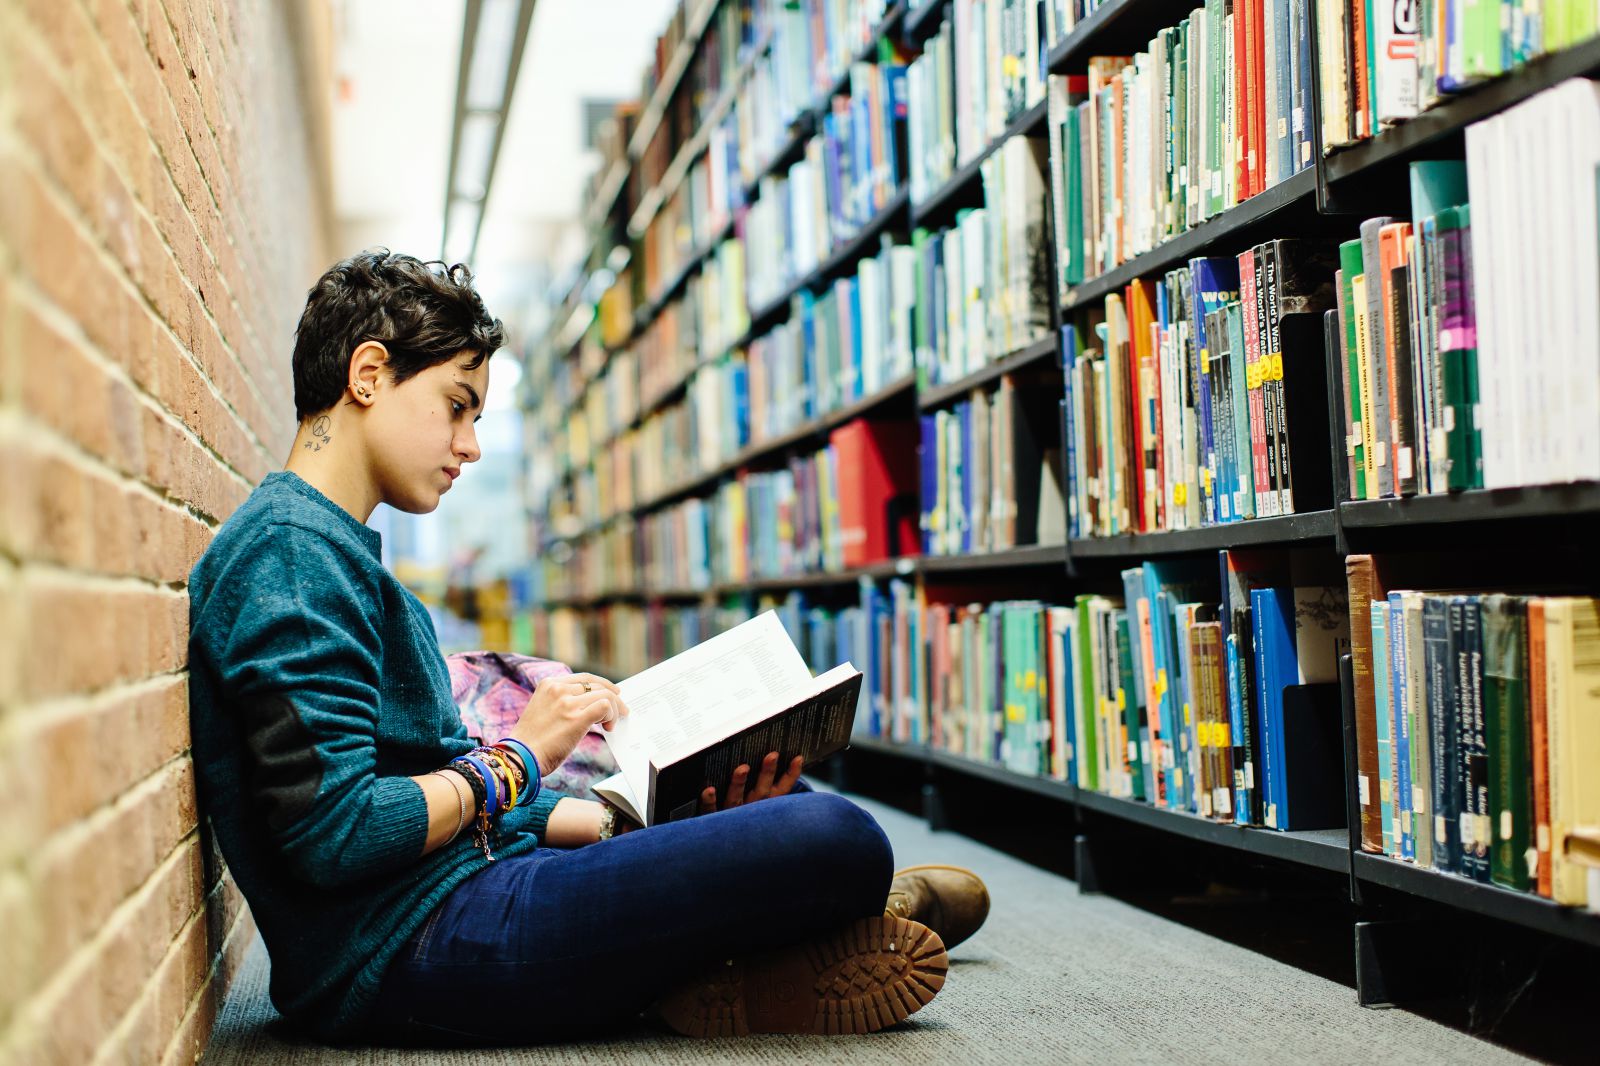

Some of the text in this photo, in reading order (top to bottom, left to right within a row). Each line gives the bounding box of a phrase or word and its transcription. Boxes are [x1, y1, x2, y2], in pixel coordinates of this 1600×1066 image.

[1201, 291, 1238, 302] wor
[1257, 288, 1266, 328] World's
[1269, 284, 1278, 325] World's
[1242, 301, 1250, 341] World's
[1249, 300, 1257, 340] World's
[1271, 326, 1280, 353] Wate
[1259, 329, 1268, 355] Wate
[1396, 612, 1408, 739] Atmospheric Pollution
[1458, 652, 1472, 729] Fundamentals
[1471, 652, 1484, 730] Fundamentals
[1240, 657, 1252, 762] DRINKING WATER QUALITY
[1436, 662, 1445, 733] Atmospheric
[1462, 734, 1472, 745] of
[1475, 734, 1486, 749] of
[1478, 785, 1488, 815] llution
